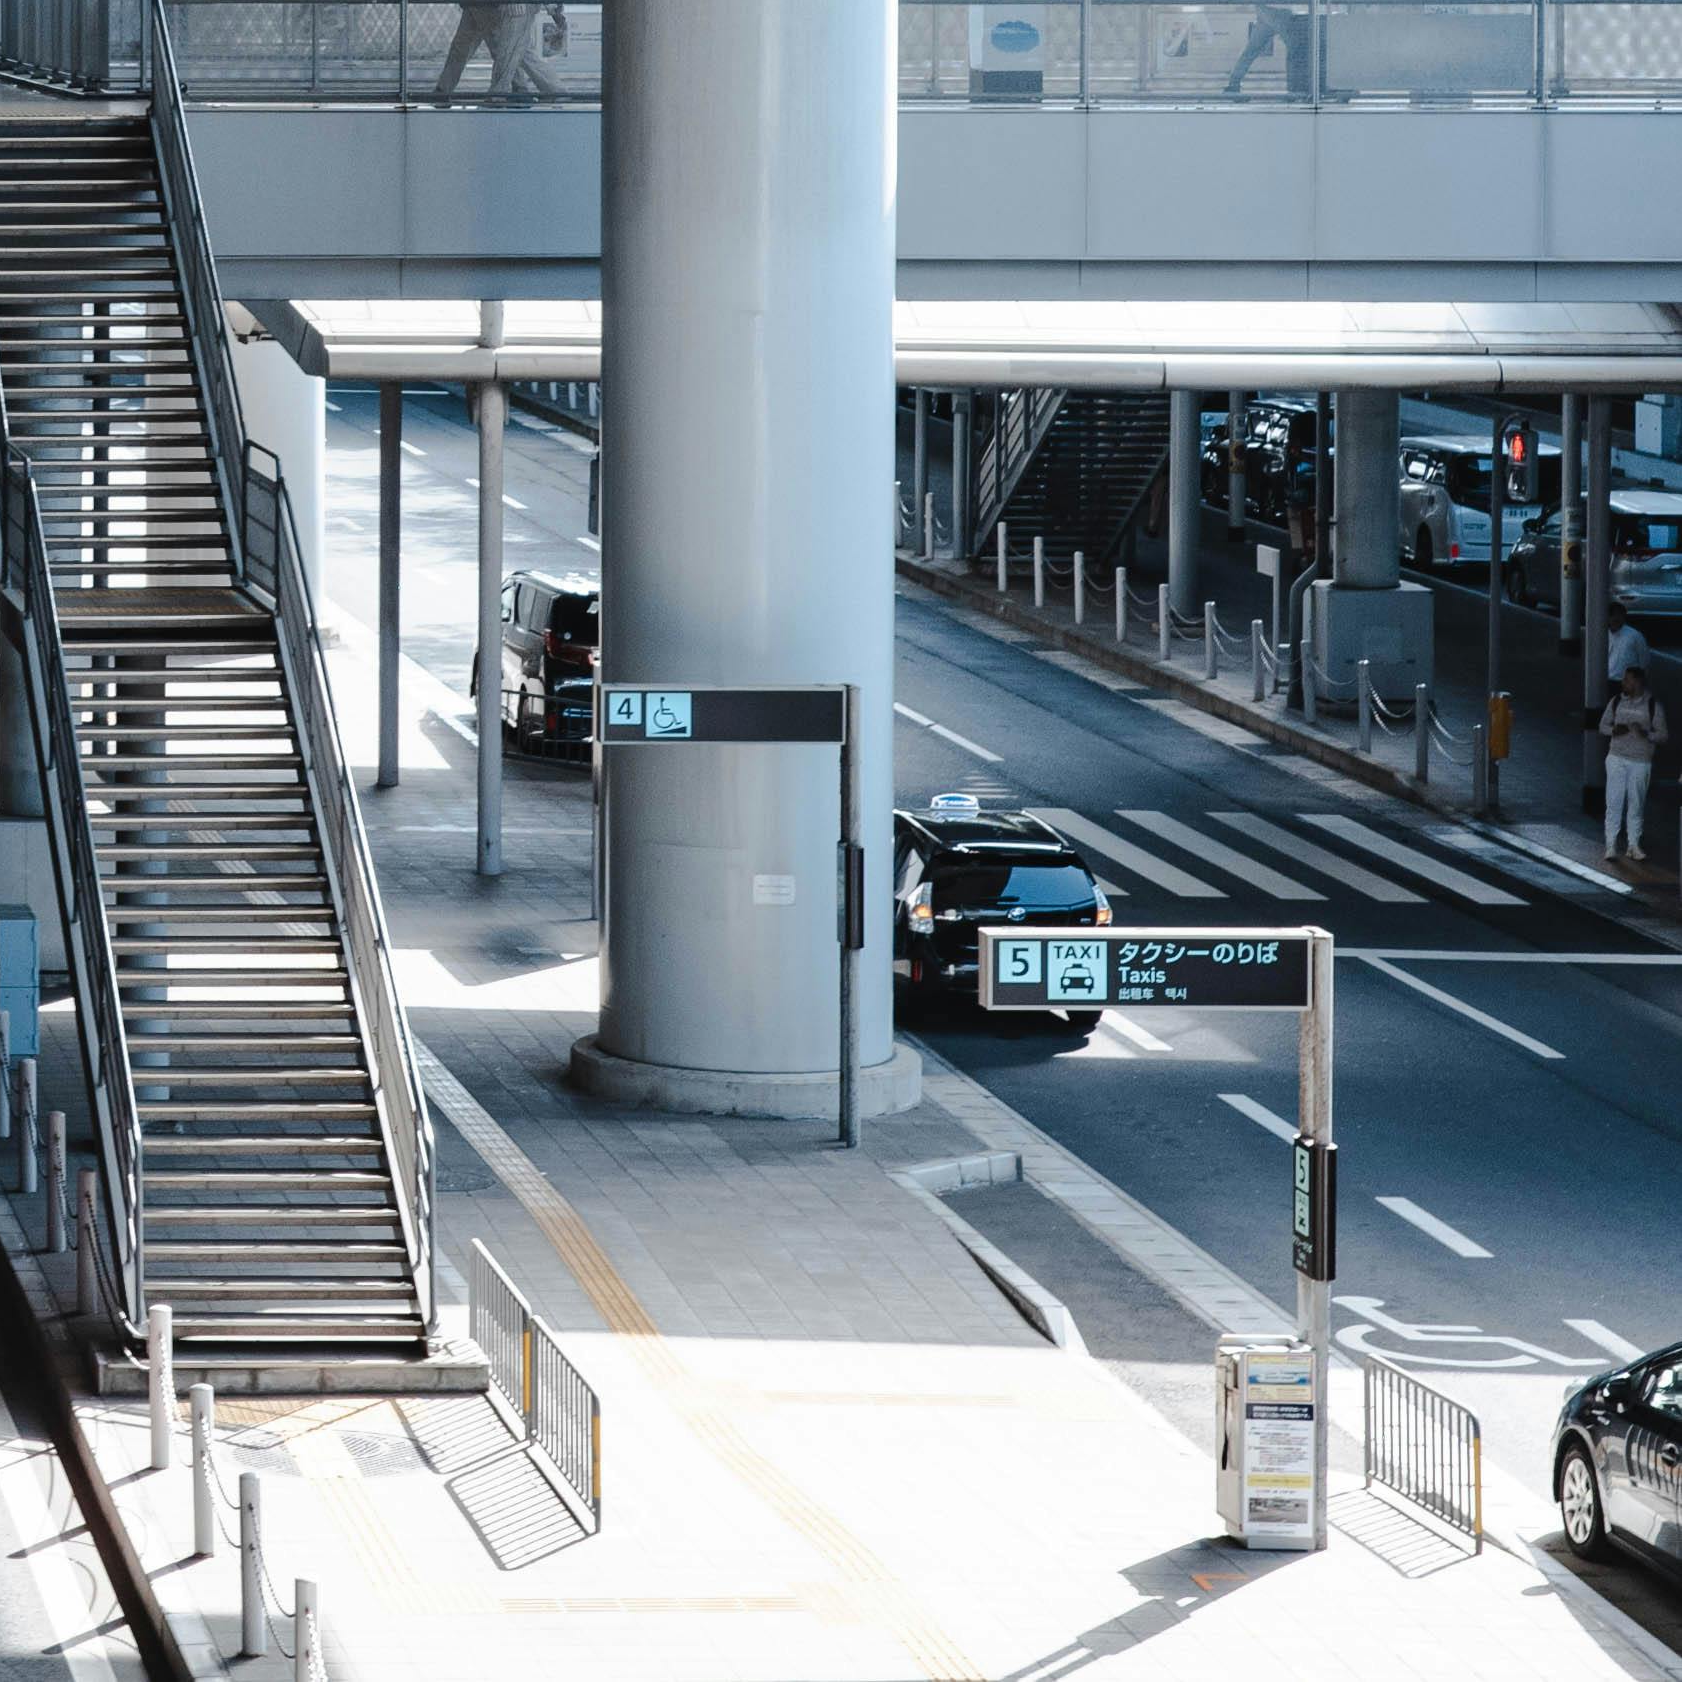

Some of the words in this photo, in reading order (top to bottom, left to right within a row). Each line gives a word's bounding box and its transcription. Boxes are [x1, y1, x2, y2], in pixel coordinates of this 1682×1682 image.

[615, 698, 633, 722] 4
[1011, 947, 1029, 977] 5
[1052, 944, 1101, 960] TAXI
[1118, 941, 1280, 965] タクシーのりば
[1118, 966, 1167, 984] Taxis
